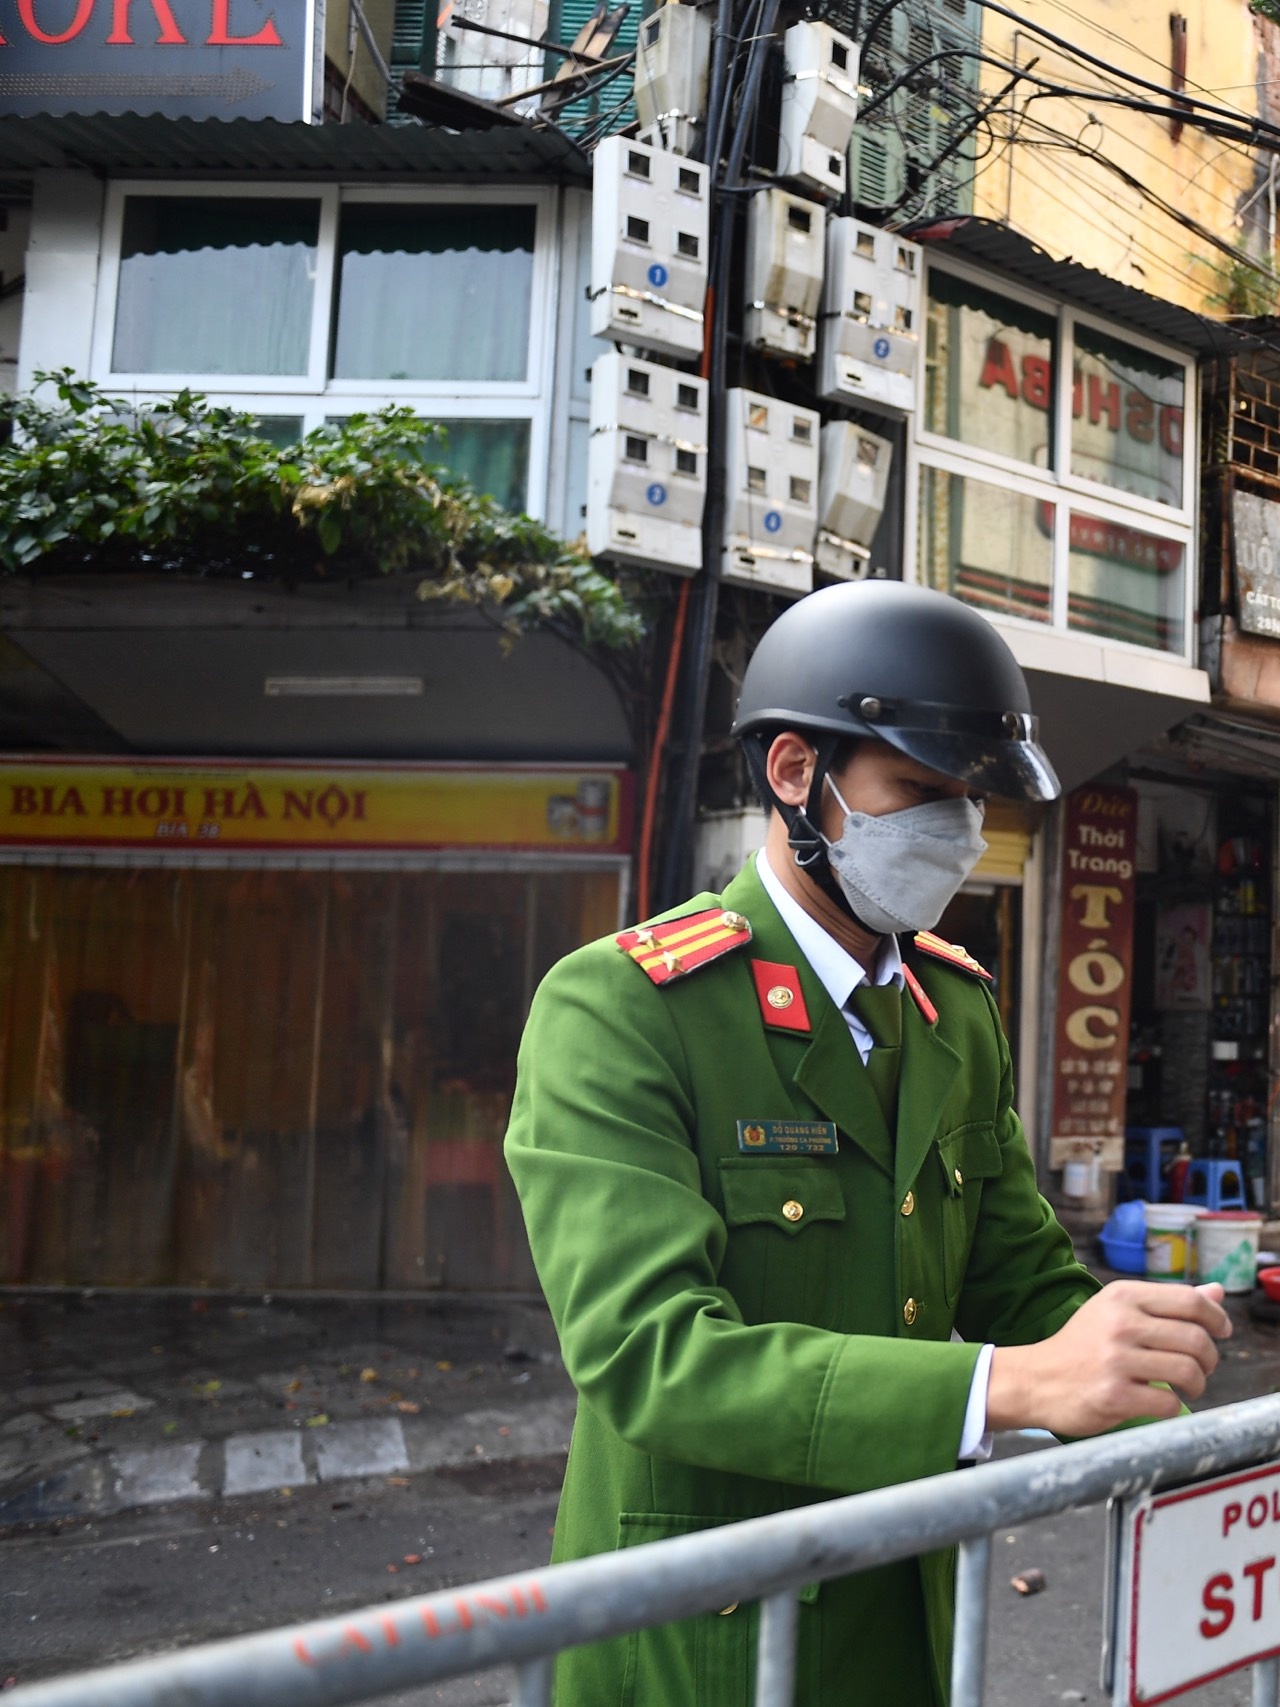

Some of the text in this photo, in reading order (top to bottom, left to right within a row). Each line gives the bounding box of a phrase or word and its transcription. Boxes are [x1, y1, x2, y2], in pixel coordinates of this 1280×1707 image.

[10, 781, 368, 829] BIA HƠI HÀ NỘI
[1078, 824, 1125, 848] Thời
[1068, 849, 1132, 879] Trang
